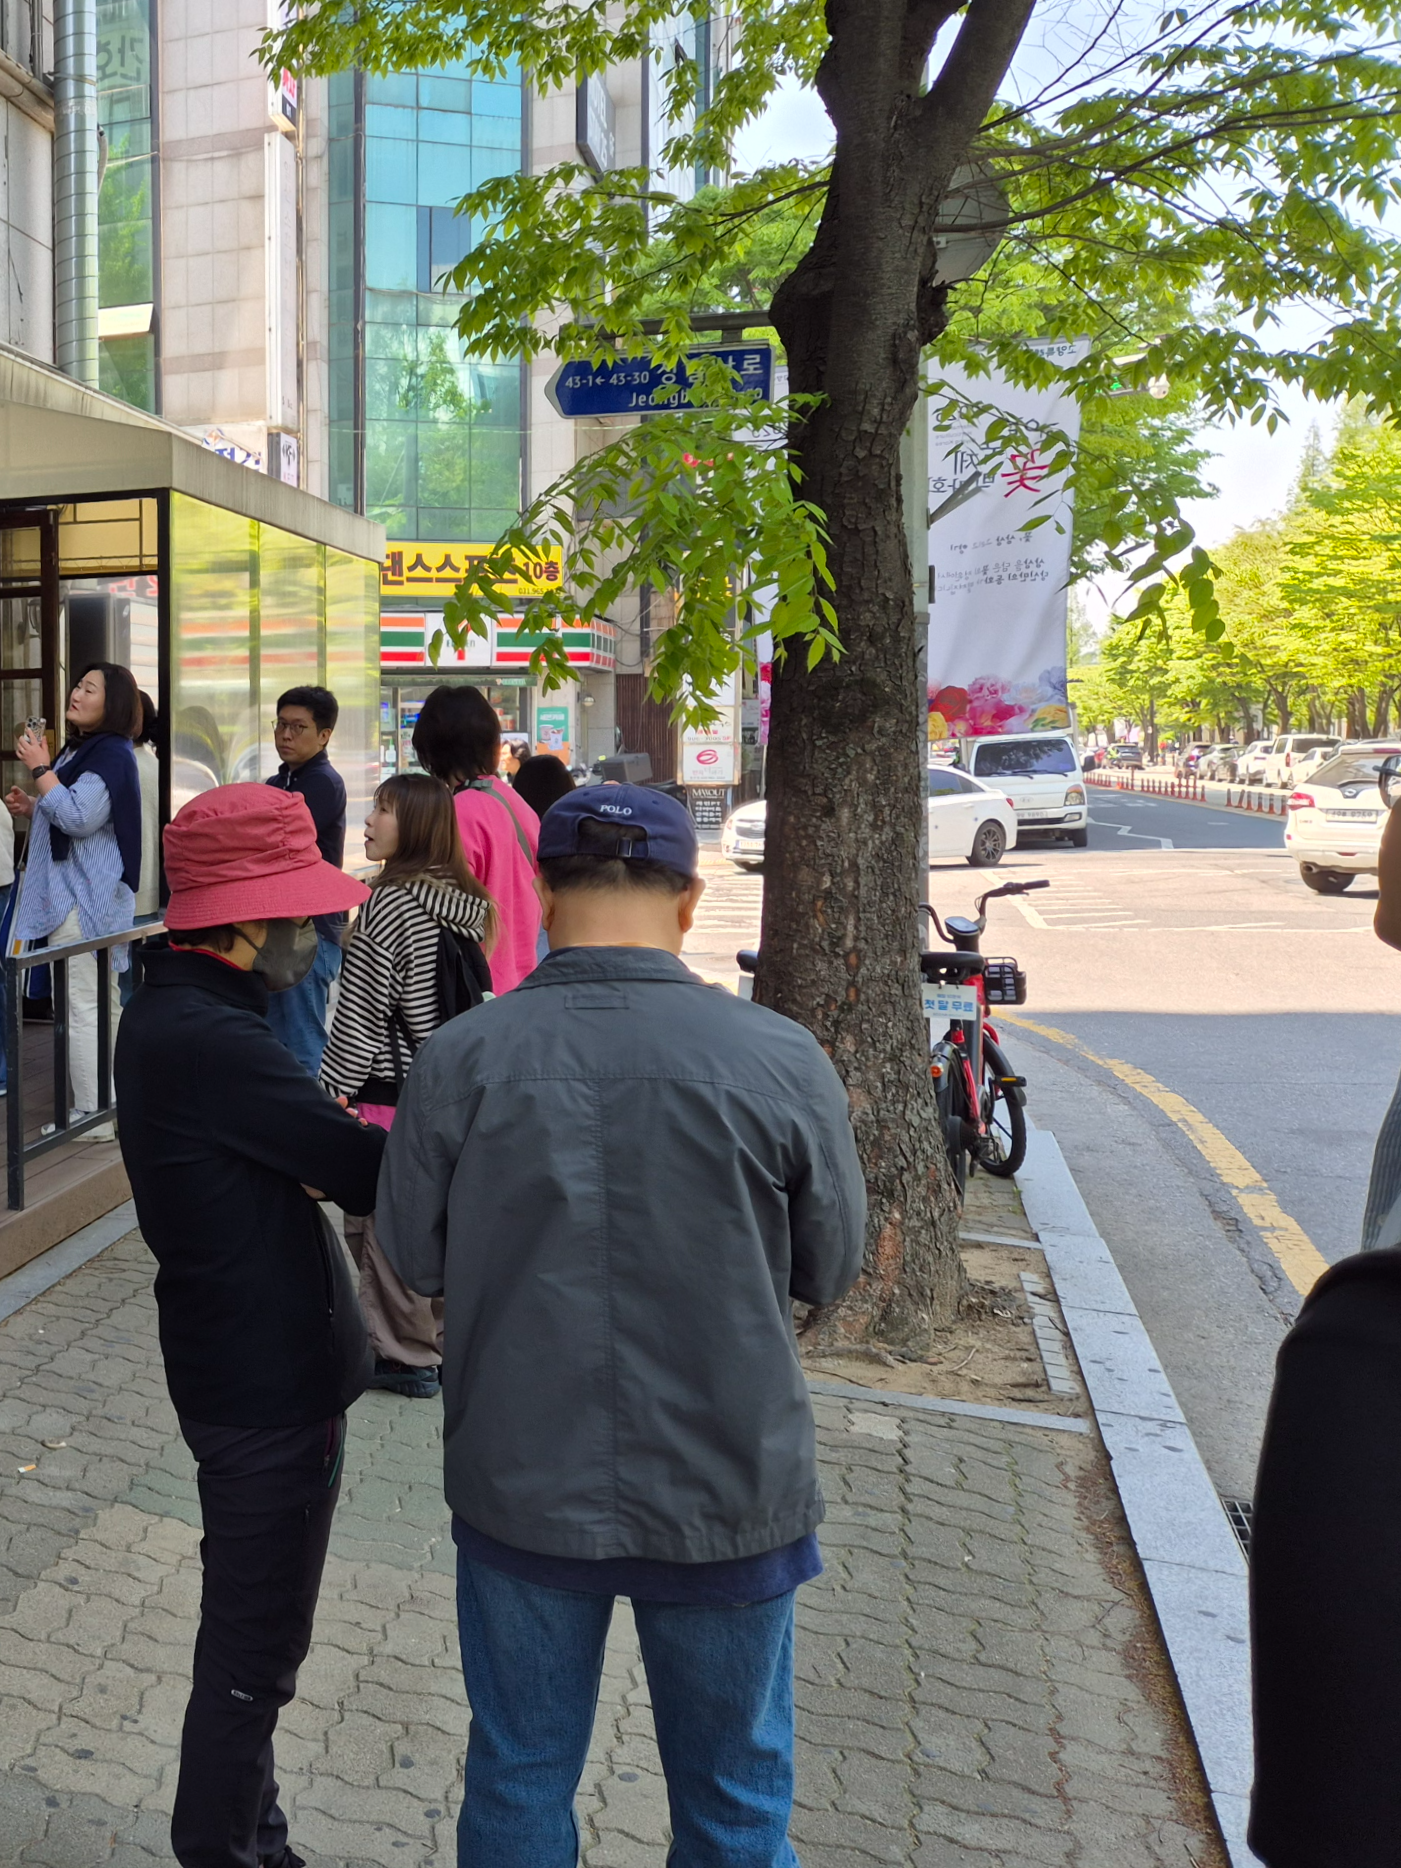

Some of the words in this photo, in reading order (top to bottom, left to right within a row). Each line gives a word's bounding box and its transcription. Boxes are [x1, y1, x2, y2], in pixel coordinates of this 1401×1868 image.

[565, 375, 593, 388] 43-1
[608, 371, 650, 386] 43-30
[600, 804, 633, 816] POLO
